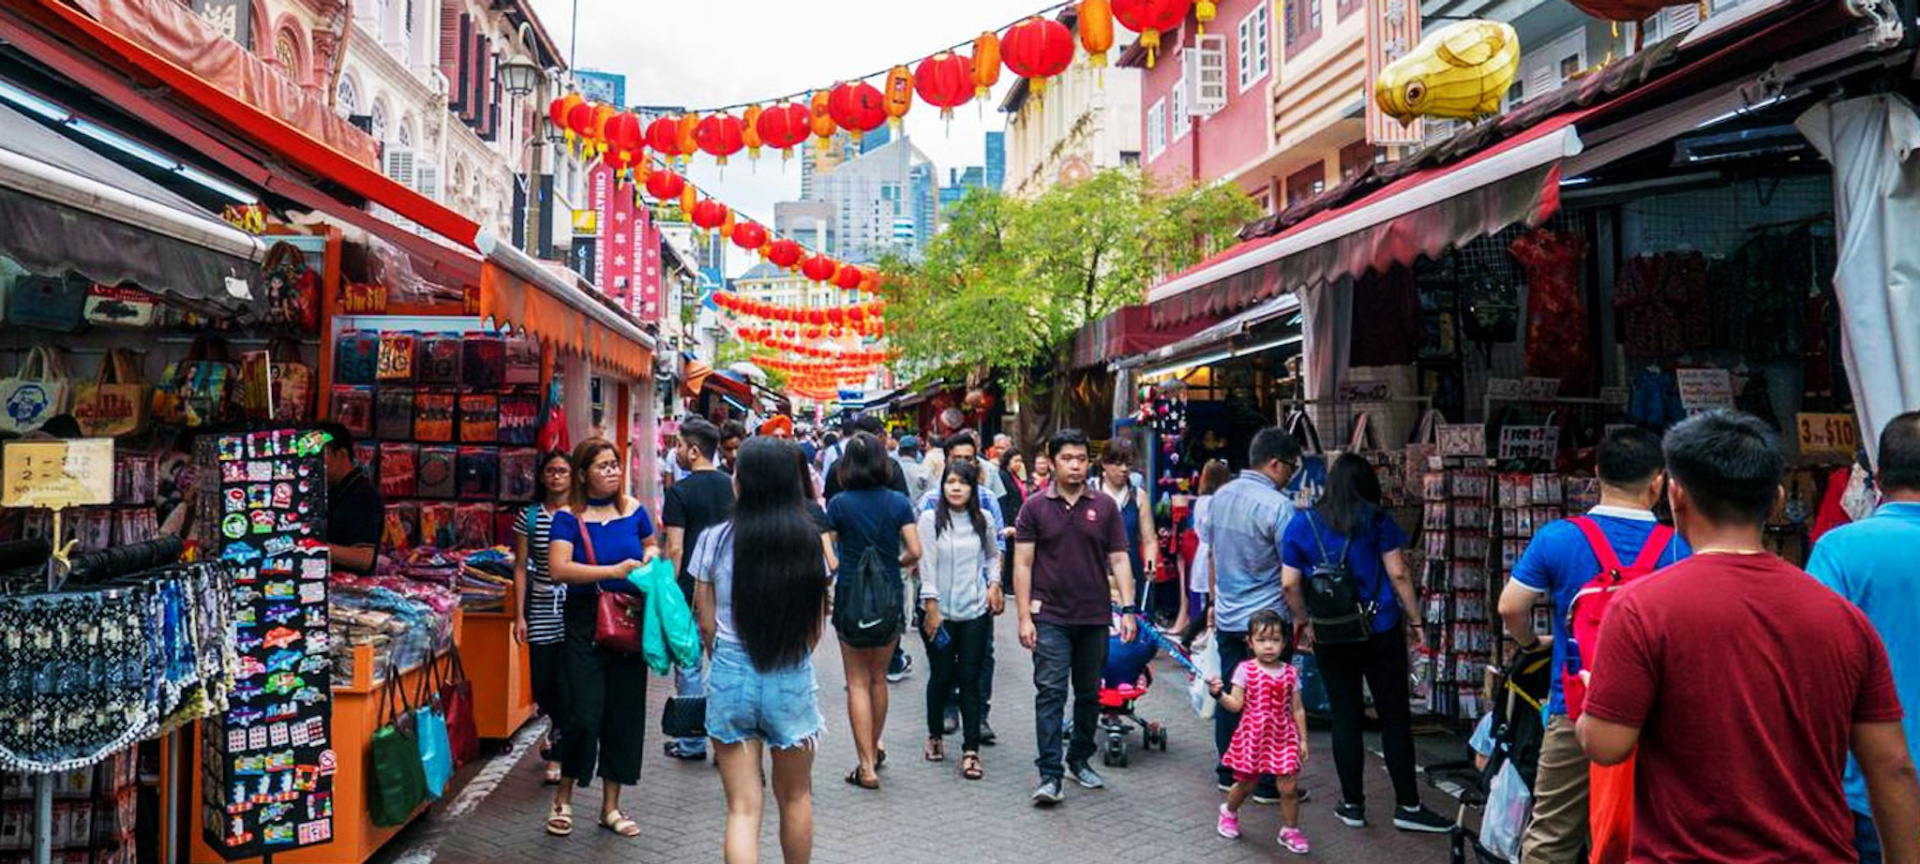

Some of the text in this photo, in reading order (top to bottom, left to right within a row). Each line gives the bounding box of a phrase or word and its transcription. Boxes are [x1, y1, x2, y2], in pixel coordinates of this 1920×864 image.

[595, 171, 606, 236] CHINATOWN
[345, 286, 353, 311] 5
[366, 286, 387, 312] $10
[1801, 418, 1811, 443] 3
[1825, 417, 1854, 446] $10
[24, 456, 31, 466] 1
[22, 470, 33, 481] 2
